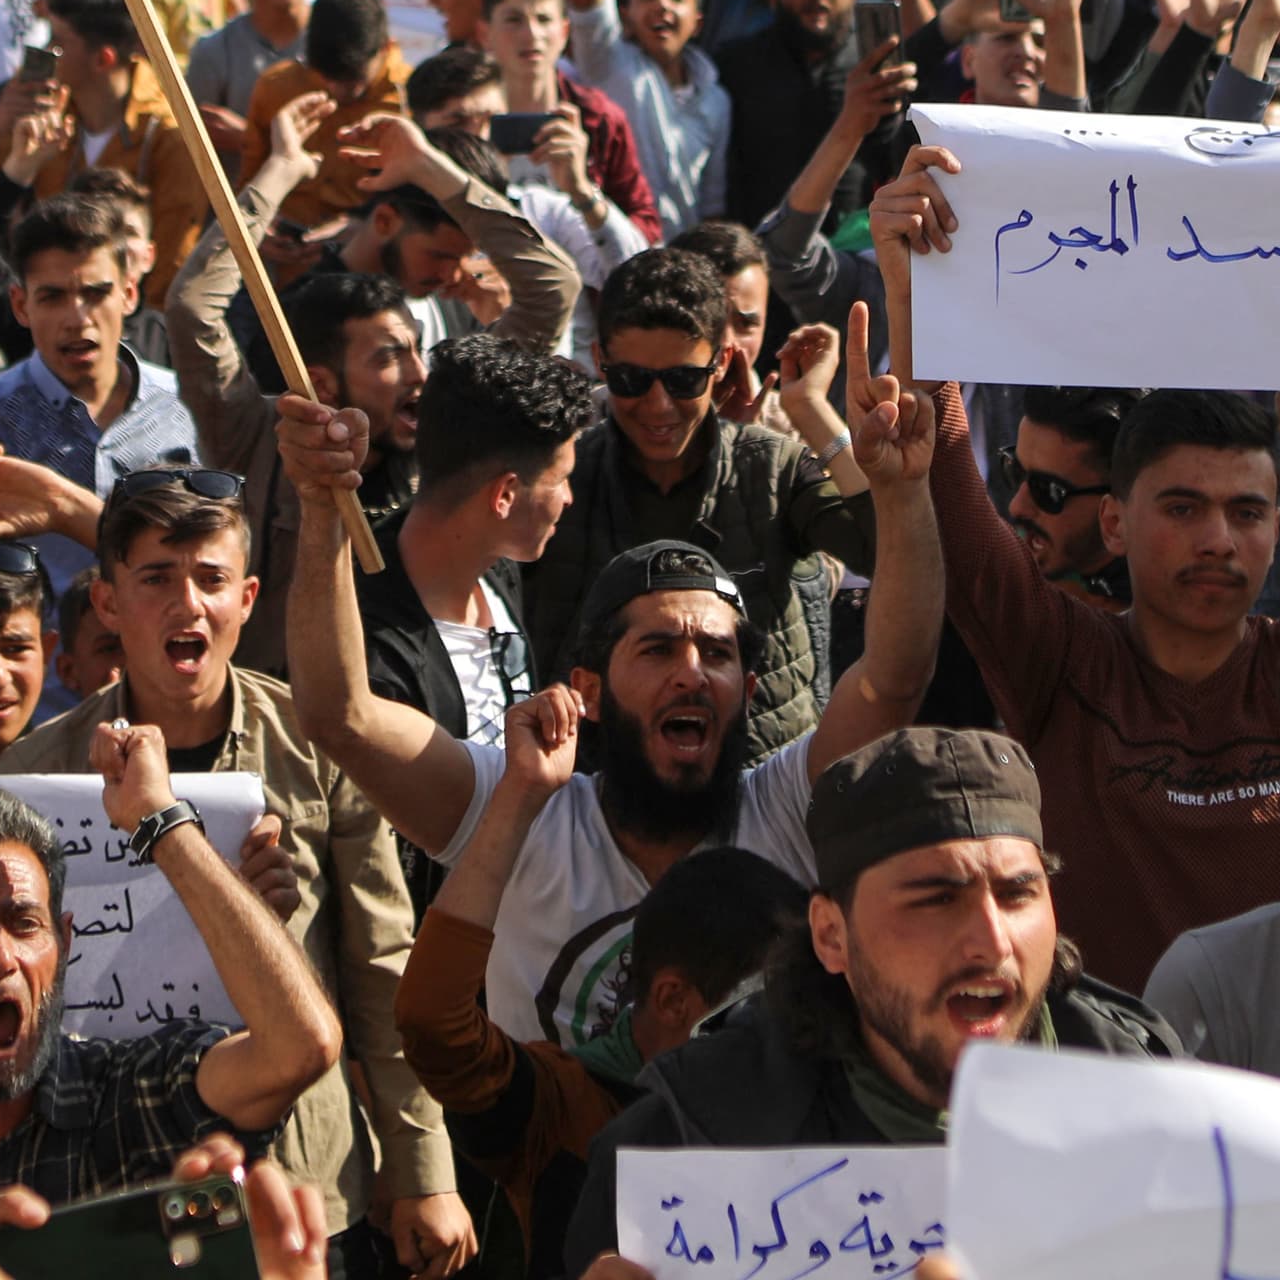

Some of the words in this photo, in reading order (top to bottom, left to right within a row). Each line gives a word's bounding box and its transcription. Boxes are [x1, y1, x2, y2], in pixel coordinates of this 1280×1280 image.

[993, 175, 1140, 307] المجرم
[1167, 789, 1205, 806] THERE
[1209, 790, 1236, 806] ARE
[1238, 786, 1256, 799] SO
